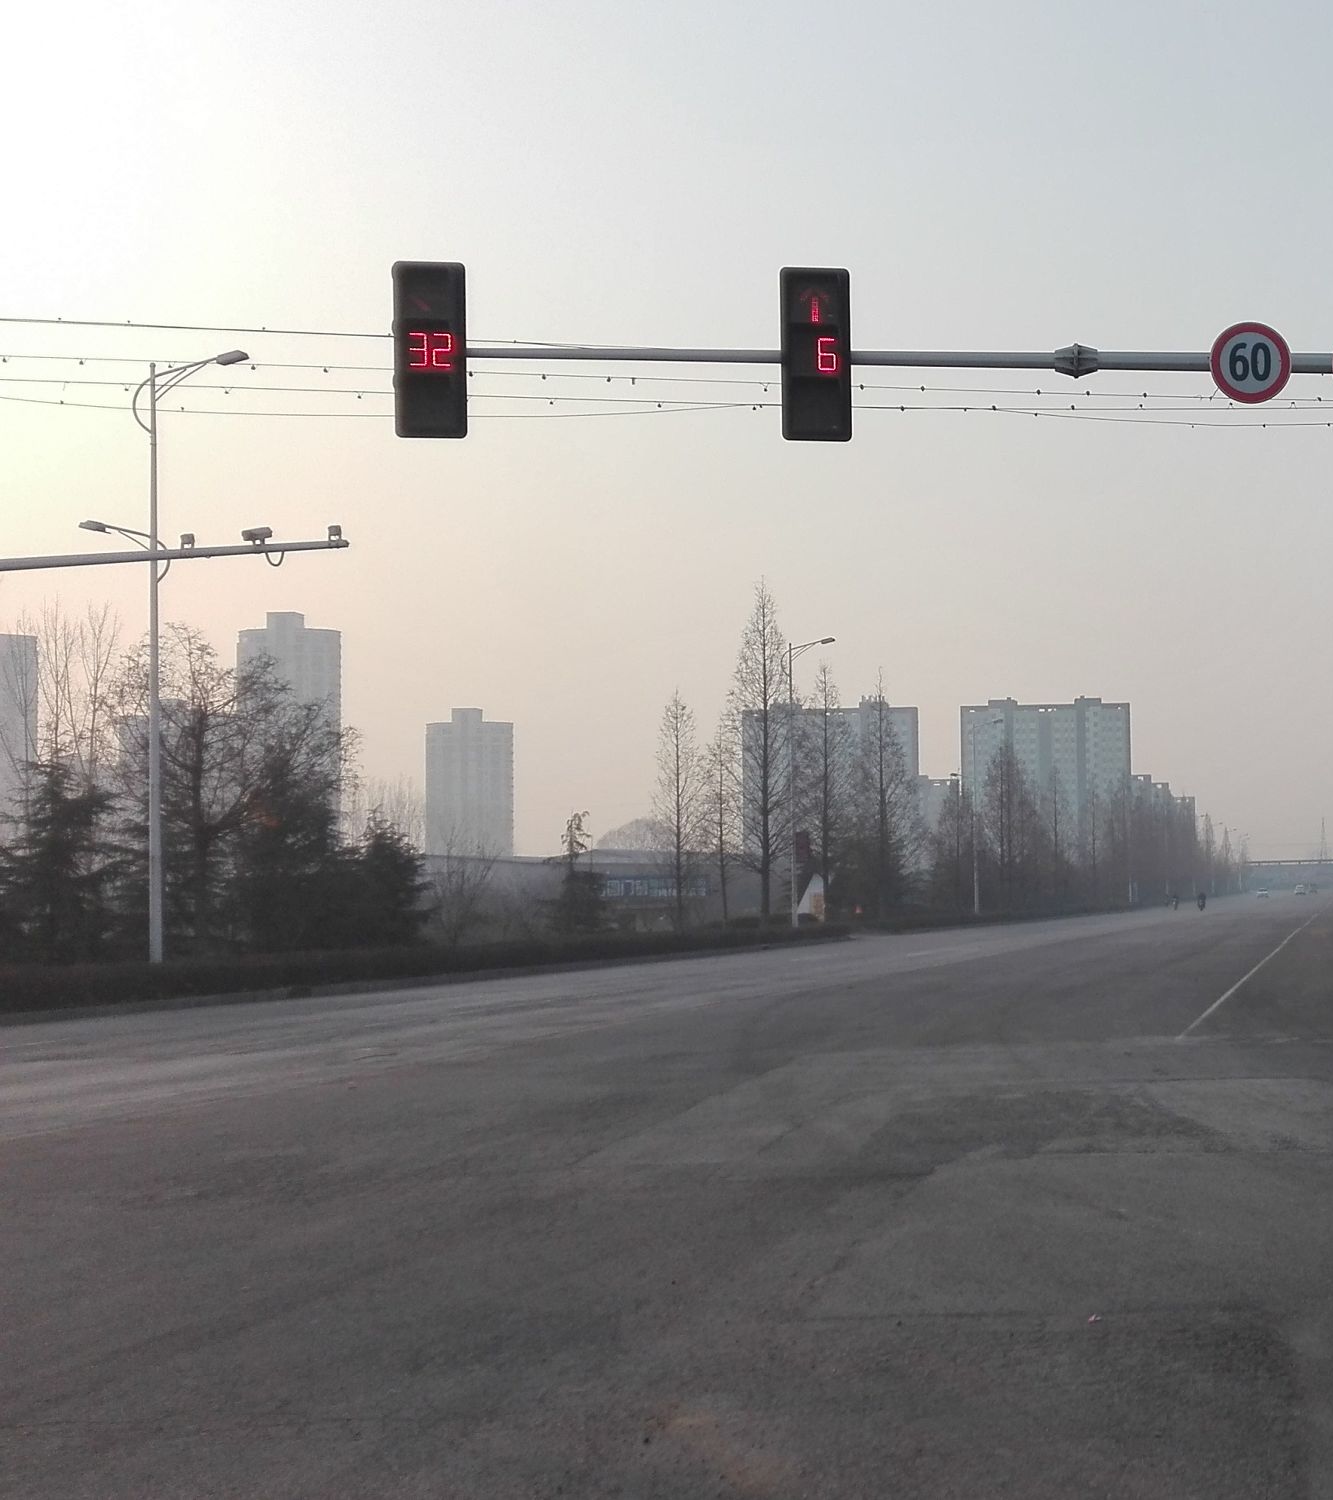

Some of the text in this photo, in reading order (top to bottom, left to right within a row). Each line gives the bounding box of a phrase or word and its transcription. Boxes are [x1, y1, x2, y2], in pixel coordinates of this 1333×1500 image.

[408, 332, 452, 367] 32
[817, 337, 836, 371] 6
[1229, 342, 1272, 382] 60
